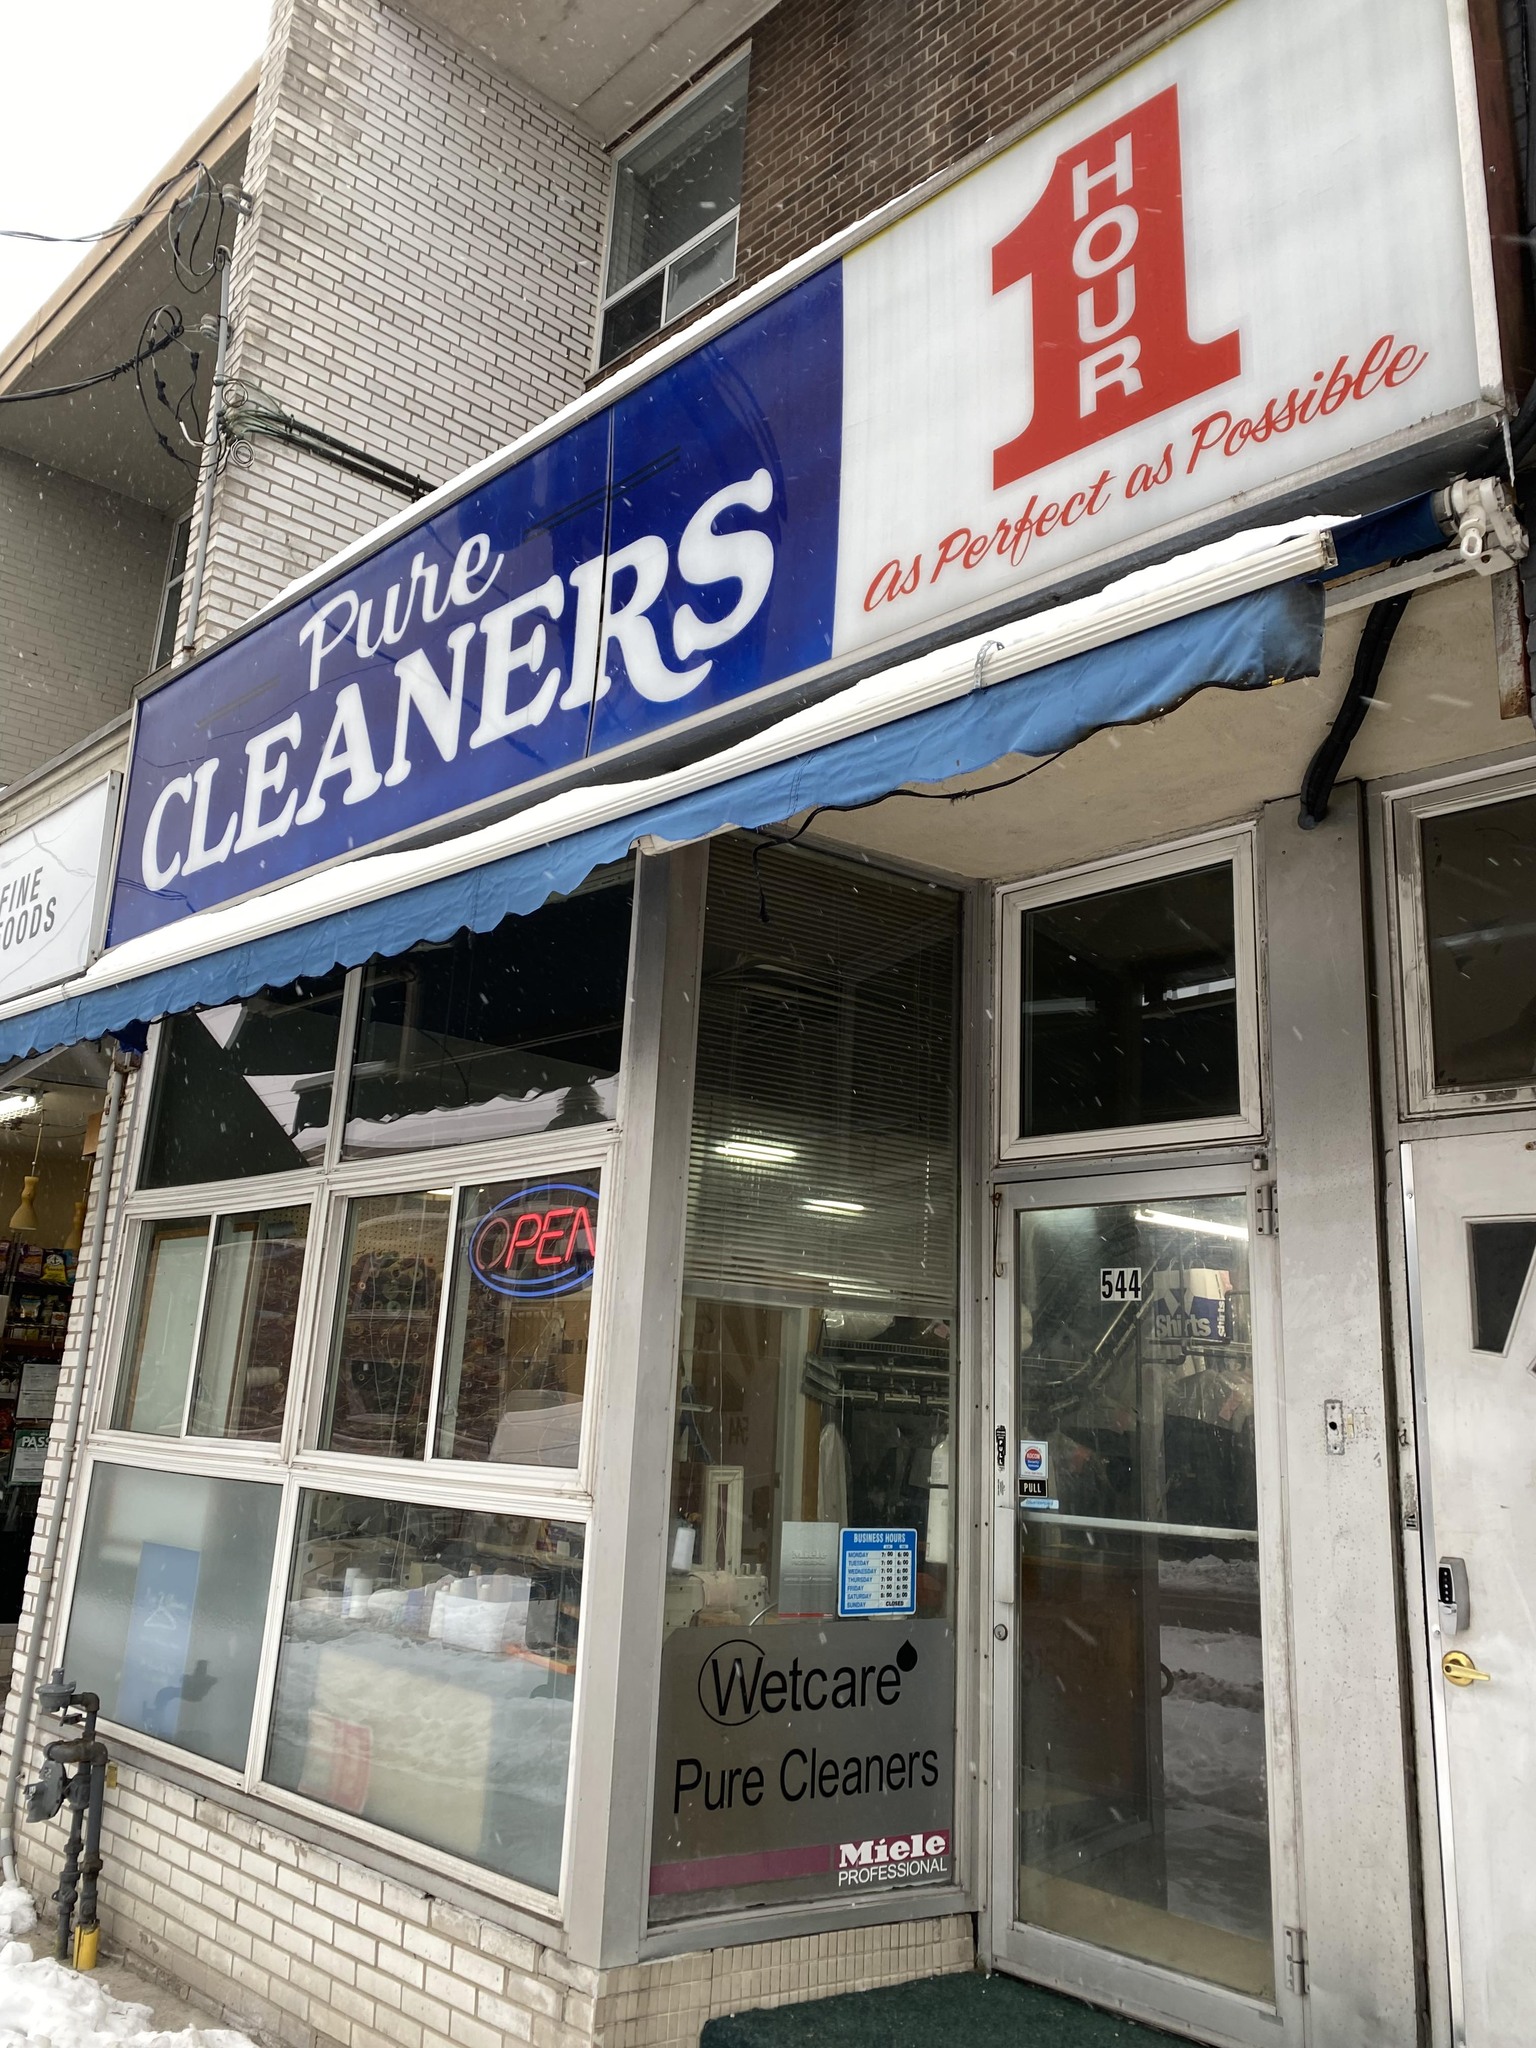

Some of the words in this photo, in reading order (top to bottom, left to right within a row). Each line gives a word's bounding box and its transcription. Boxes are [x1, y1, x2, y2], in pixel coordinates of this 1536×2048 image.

[992, 83, 1241, 490] 1
[1072, 133, 1143, 418] HOUR
[931, 471, 1117, 585] Perfect
[1125, 441, 1173, 499] as
[1187, 334, 1429, 474] Possible
[300, 534, 504, 690] Pure
[142, 468, 774, 891] CLEANERS
[1102, 1269, 1141, 1299] 544
[1156, 1314, 1212, 1337] Shirts
[1023, 1482, 1041, 1493] PULL
[854, 1533, 883, 1543] BUSINESS
[885, 1533, 906, 1543] HOURS
[712, 1656, 902, 1716] Wetcare
[673, 1758, 765, 1814] Pure
[780, 1748, 939, 1802] Cleaners
[838, 1858, 948, 1887] PROFESSIONAL
[839, 1833, 947, 1869] Miele
